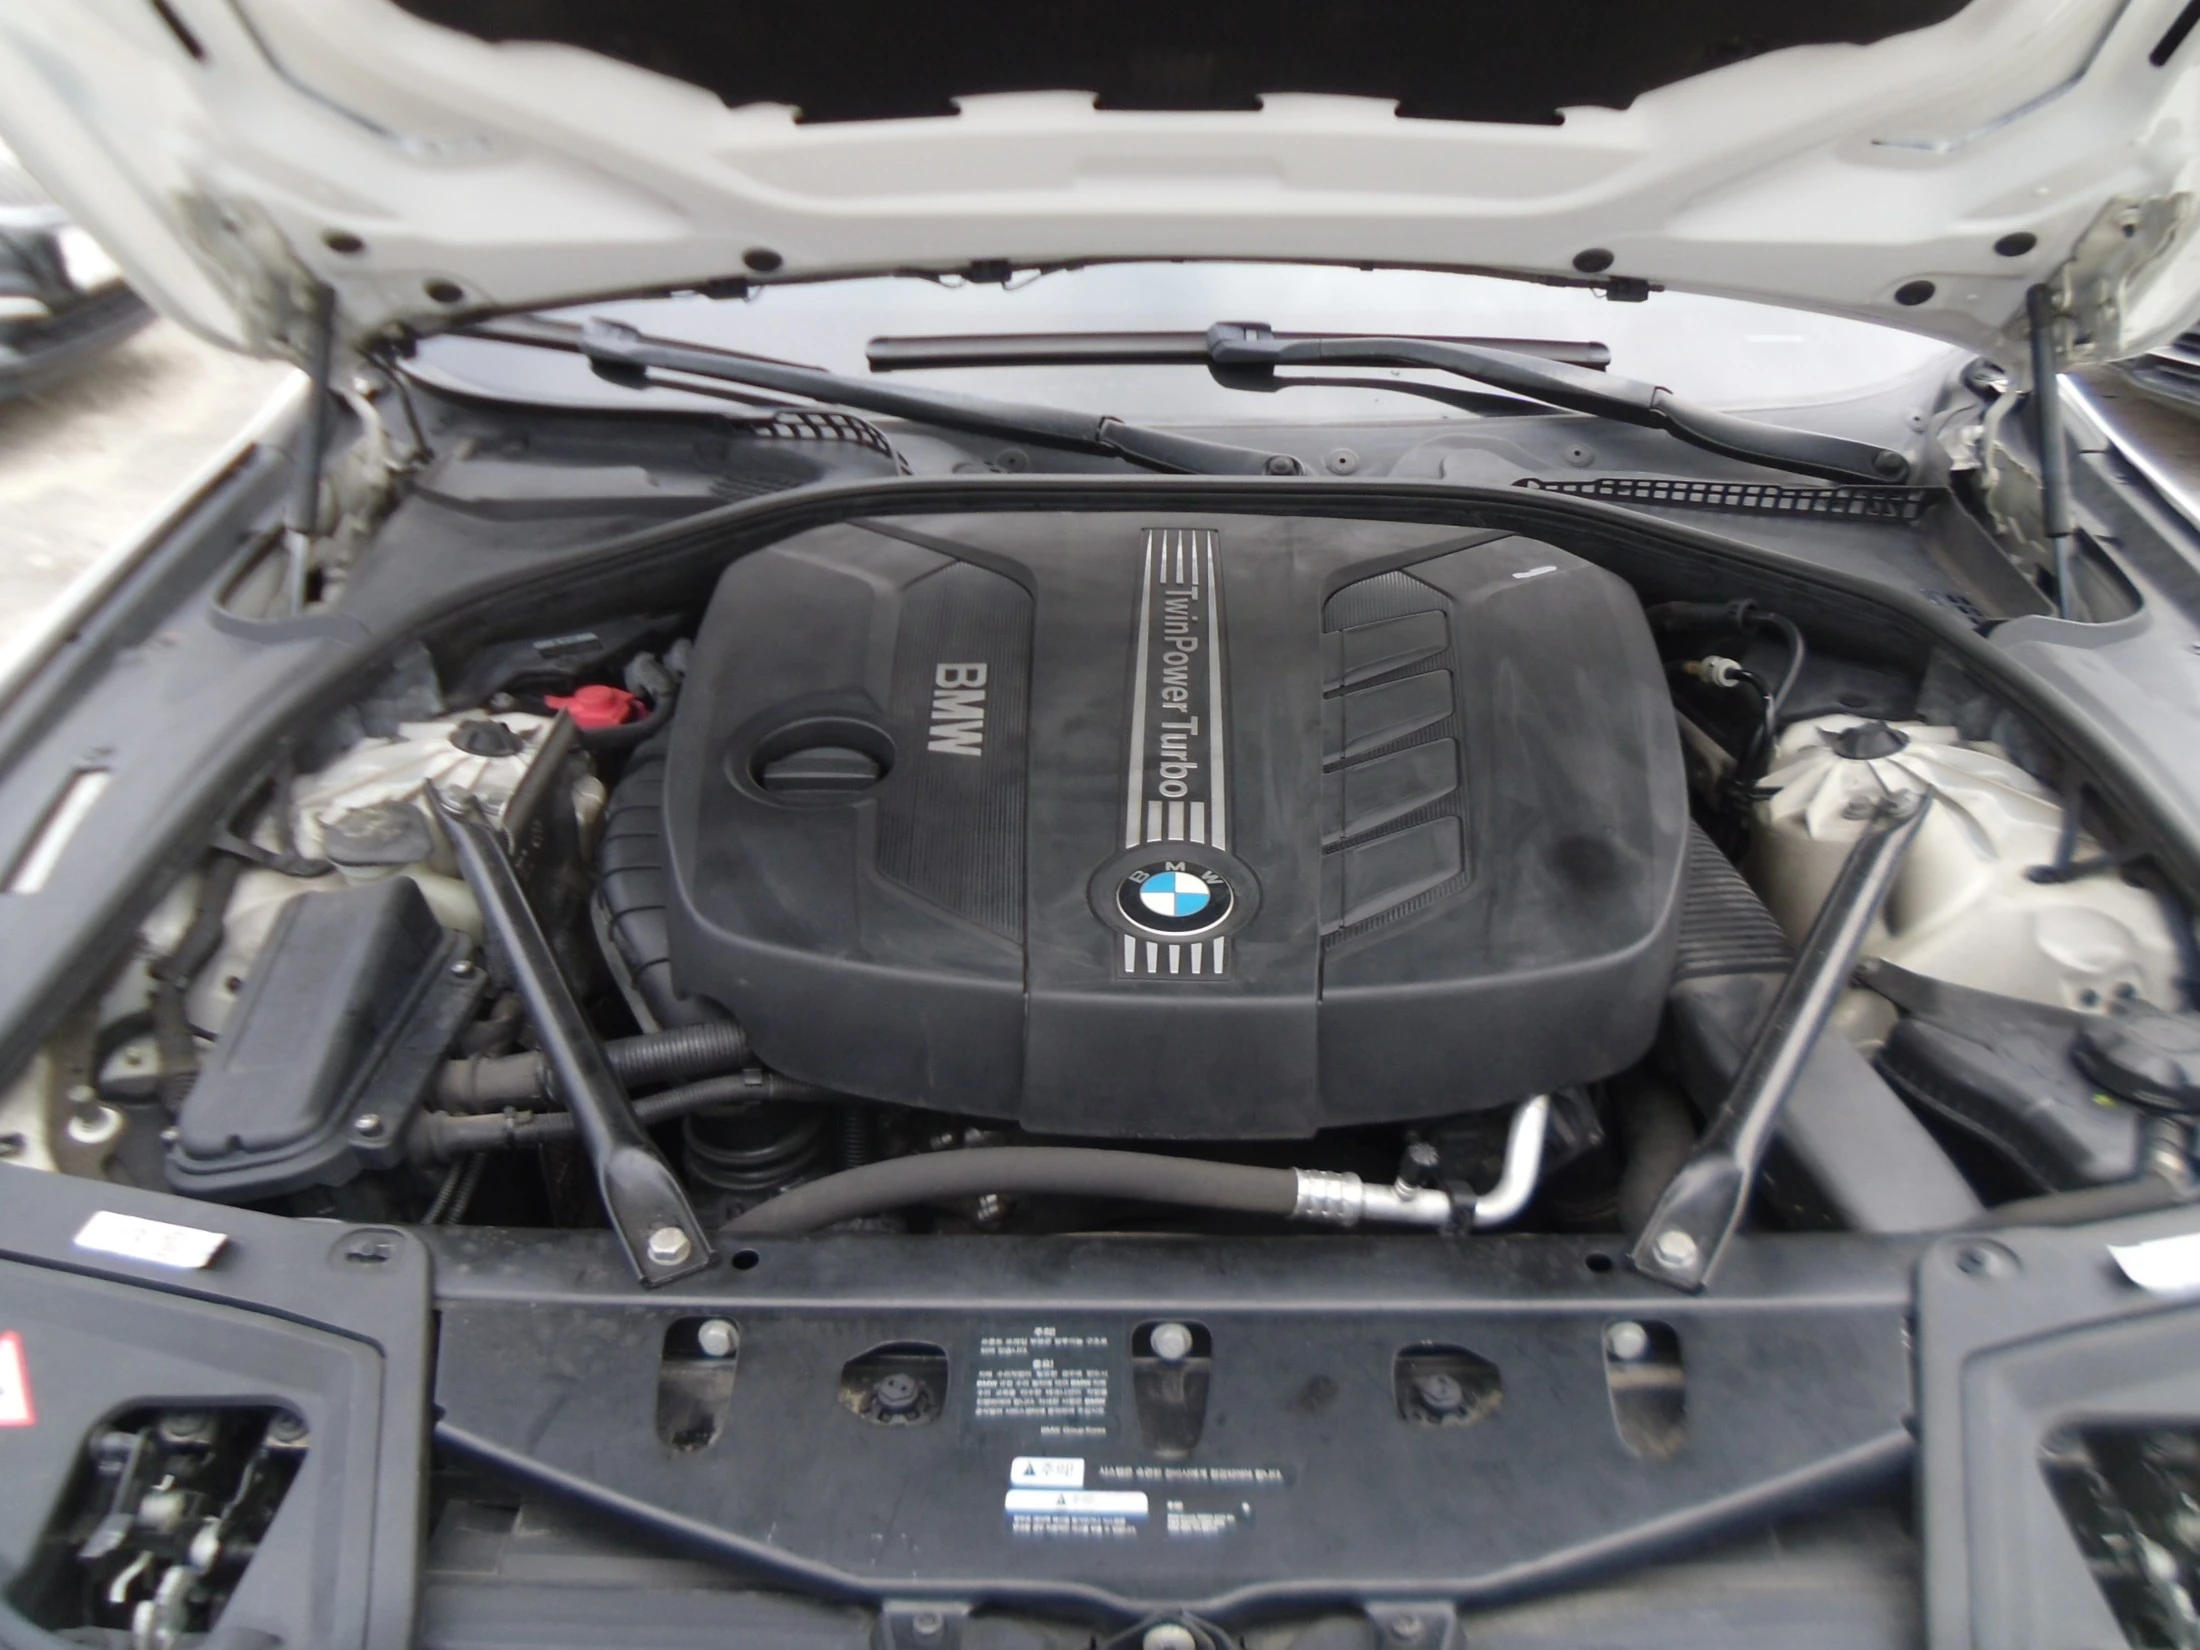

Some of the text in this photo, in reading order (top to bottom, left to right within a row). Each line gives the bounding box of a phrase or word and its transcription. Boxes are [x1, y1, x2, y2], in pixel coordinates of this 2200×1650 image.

[927, 663, 987, 756] BMW
[1159, 586, 1198, 798] TwinPower Turbo
[1128, 861, 1223, 886] BMW
